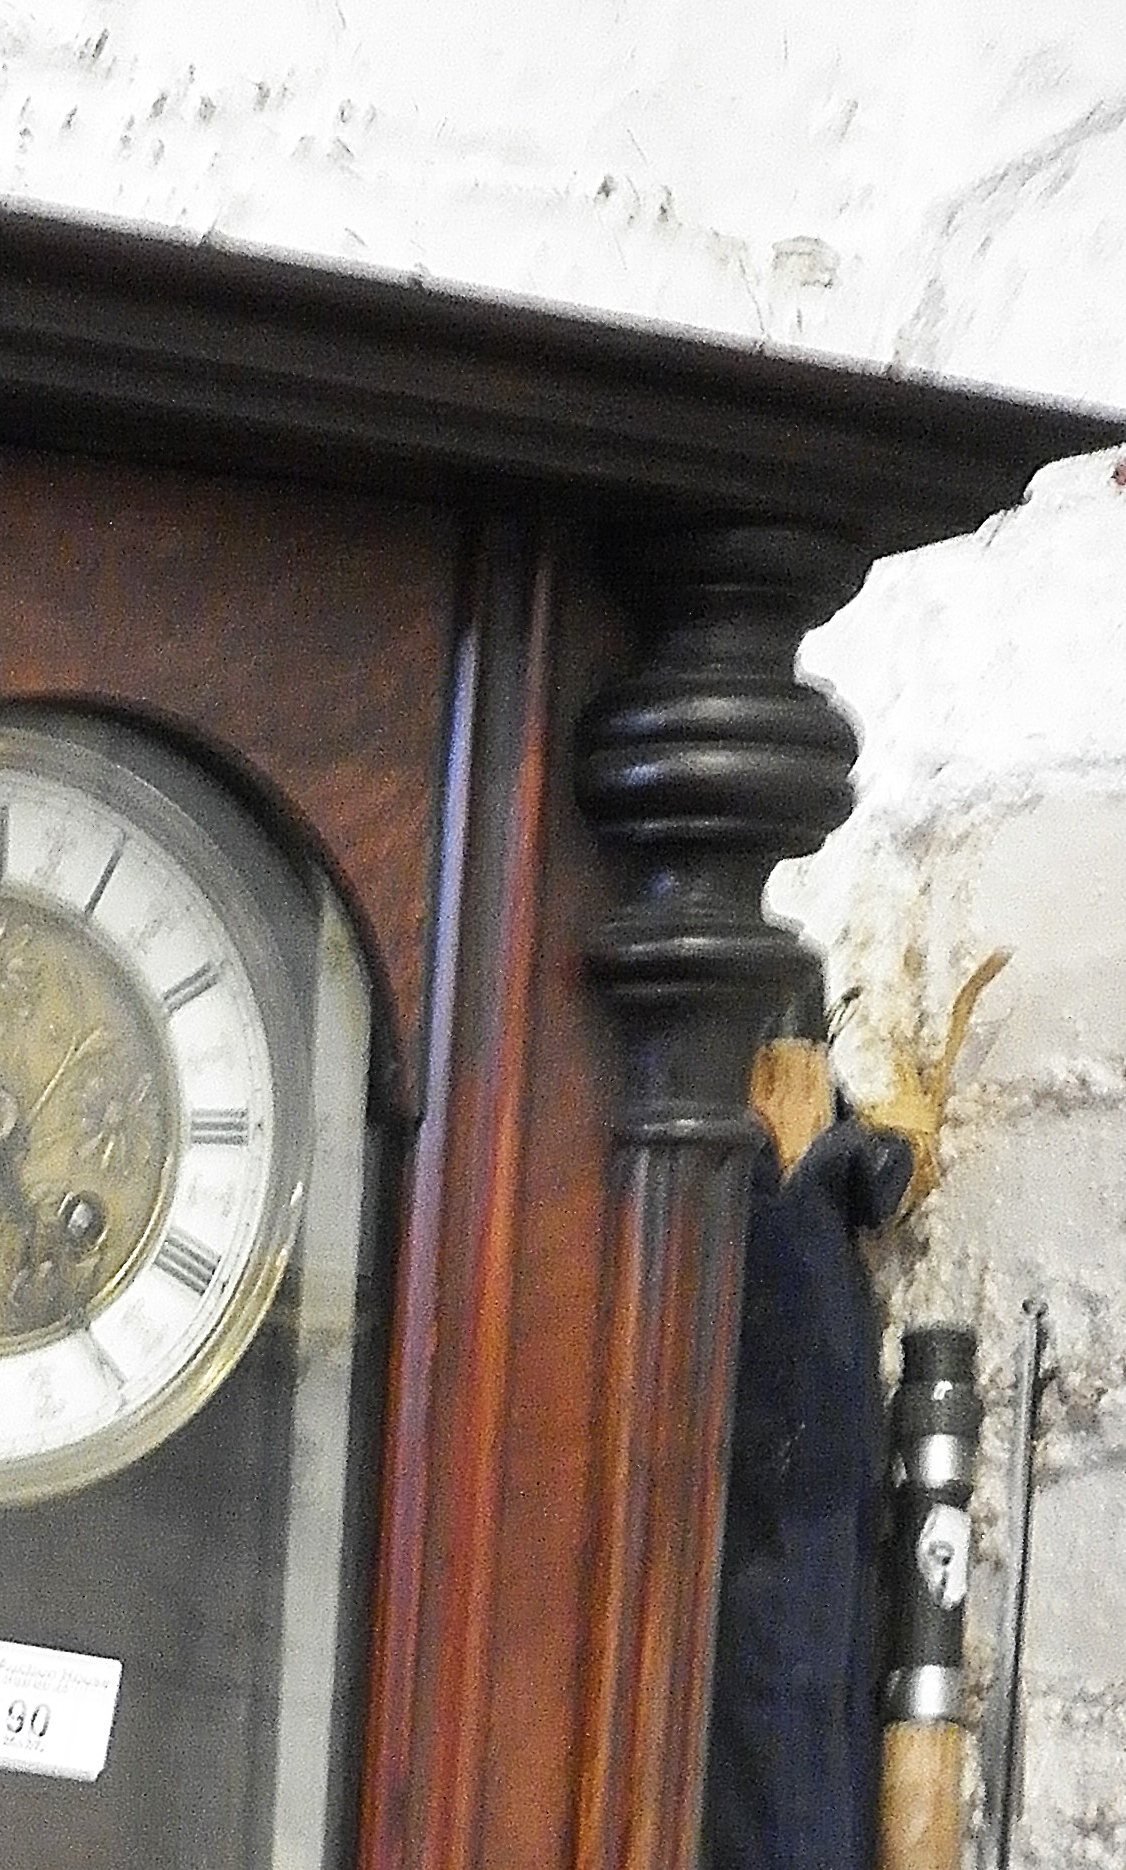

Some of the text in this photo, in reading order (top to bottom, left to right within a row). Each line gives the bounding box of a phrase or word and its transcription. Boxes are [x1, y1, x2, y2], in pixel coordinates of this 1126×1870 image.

[82, 843, 125, 918] I
[163, 961, 221, 1014] II
[189, 1107, 249, 1146] III
[6, 1699, 51, 1738] 90
